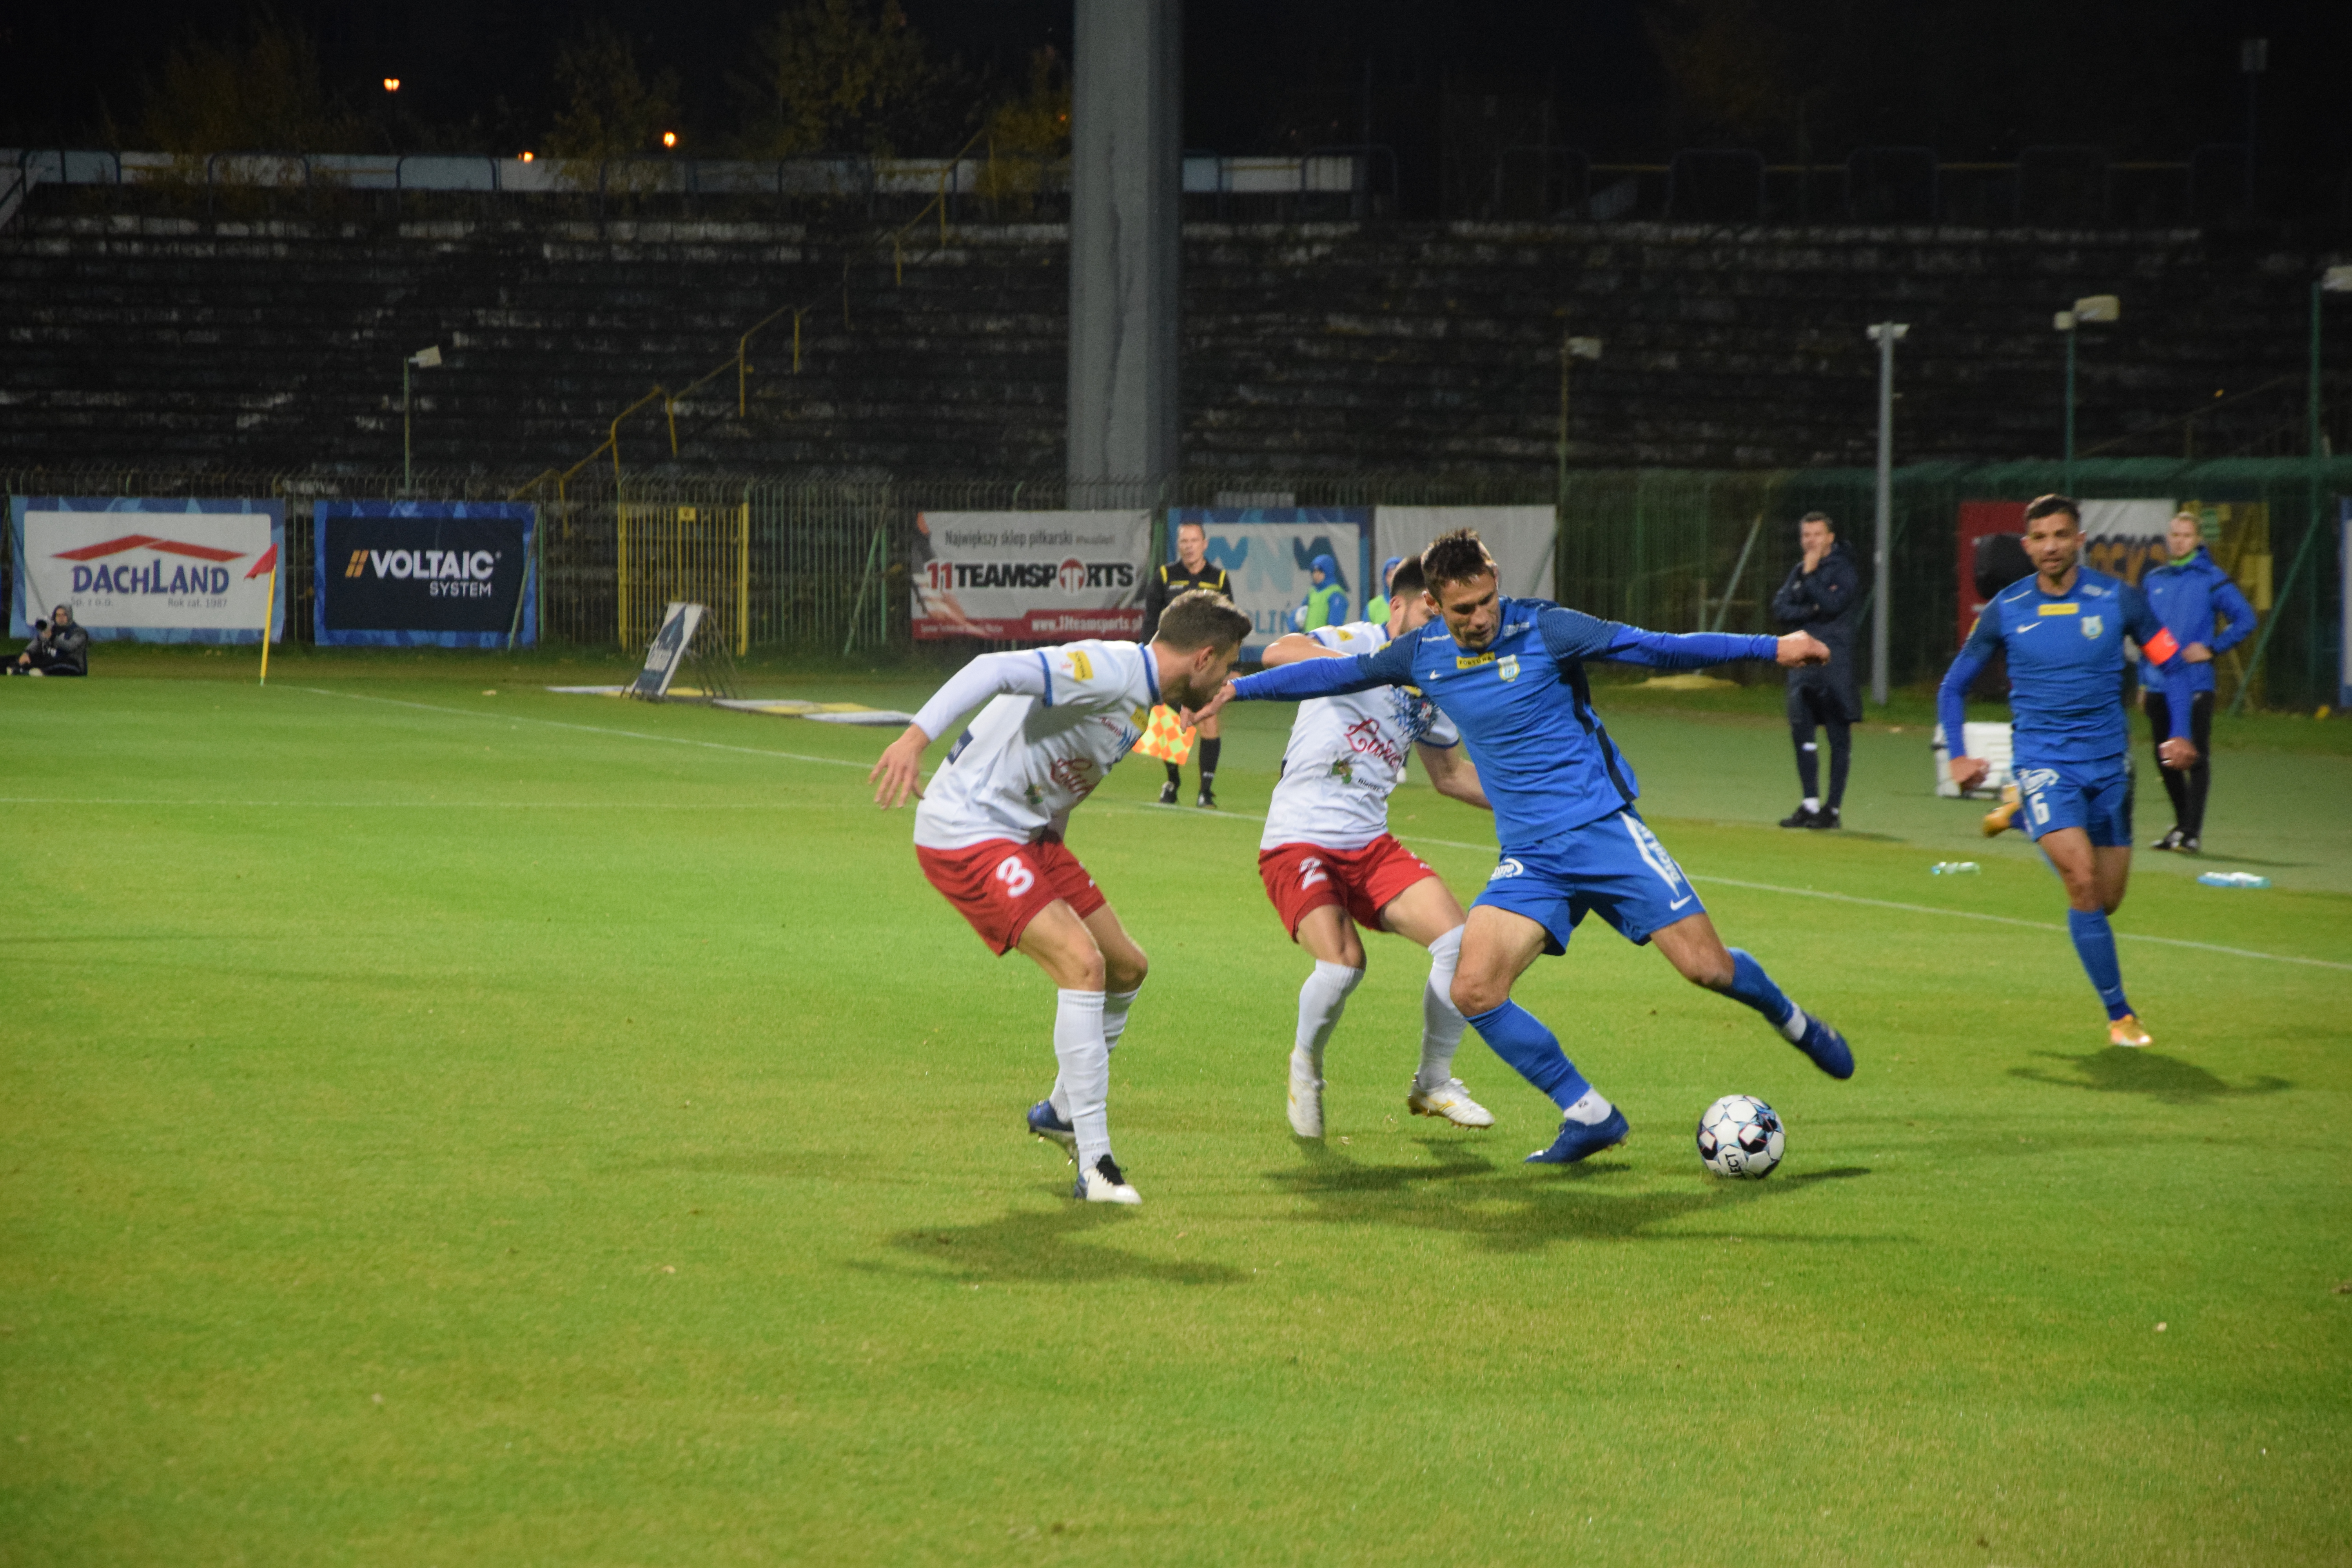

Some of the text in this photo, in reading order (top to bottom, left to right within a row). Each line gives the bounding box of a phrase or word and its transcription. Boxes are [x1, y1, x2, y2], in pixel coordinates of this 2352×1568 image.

[1001, 530, 1027, 548] sklep
[72, 559, 230, 595] DACHLAND
[370, 550, 494, 579] VOLTAIC
[168, 597, 184, 607] Rok
[206, 597, 227, 608] 1987
[430, 582, 491, 597] SYSTEM
[1459, 655, 1492, 665] FORTUNA
[2029, 792, 2051, 825] 6
[996, 856, 1034, 897] 3
[1299, 856, 1328, 891] 2
